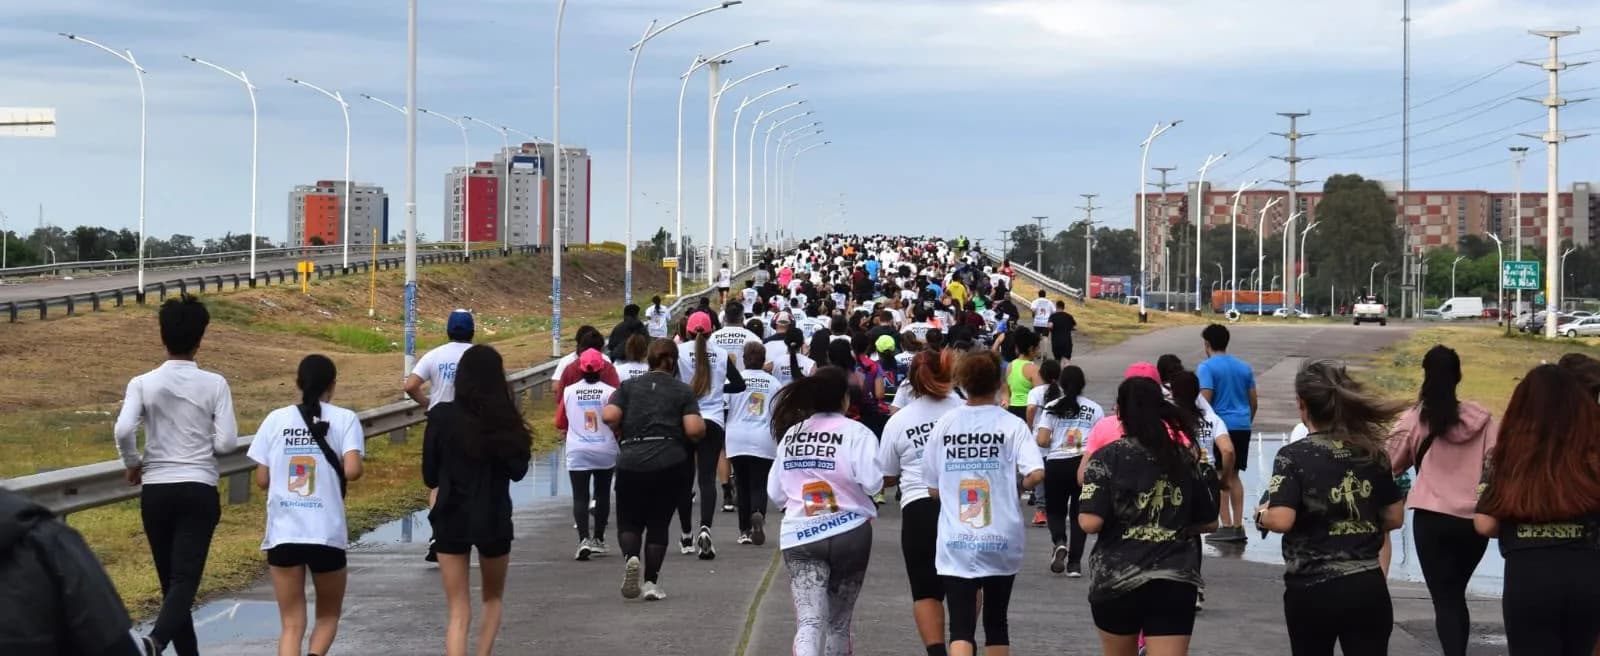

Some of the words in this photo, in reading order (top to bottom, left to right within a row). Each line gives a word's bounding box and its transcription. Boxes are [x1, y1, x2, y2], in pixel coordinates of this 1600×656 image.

[285, 438, 319, 446] NEDE
[784, 432, 843, 445] PICHON
[943, 433, 1005, 447] PICHON
[784, 445, 836, 458] NEDER
[946, 446, 1000, 459] NEDER
[785, 460, 817, 470] SENADOR
[817, 460, 834, 469] 2025
[946, 462, 981, 471] SENADOR
